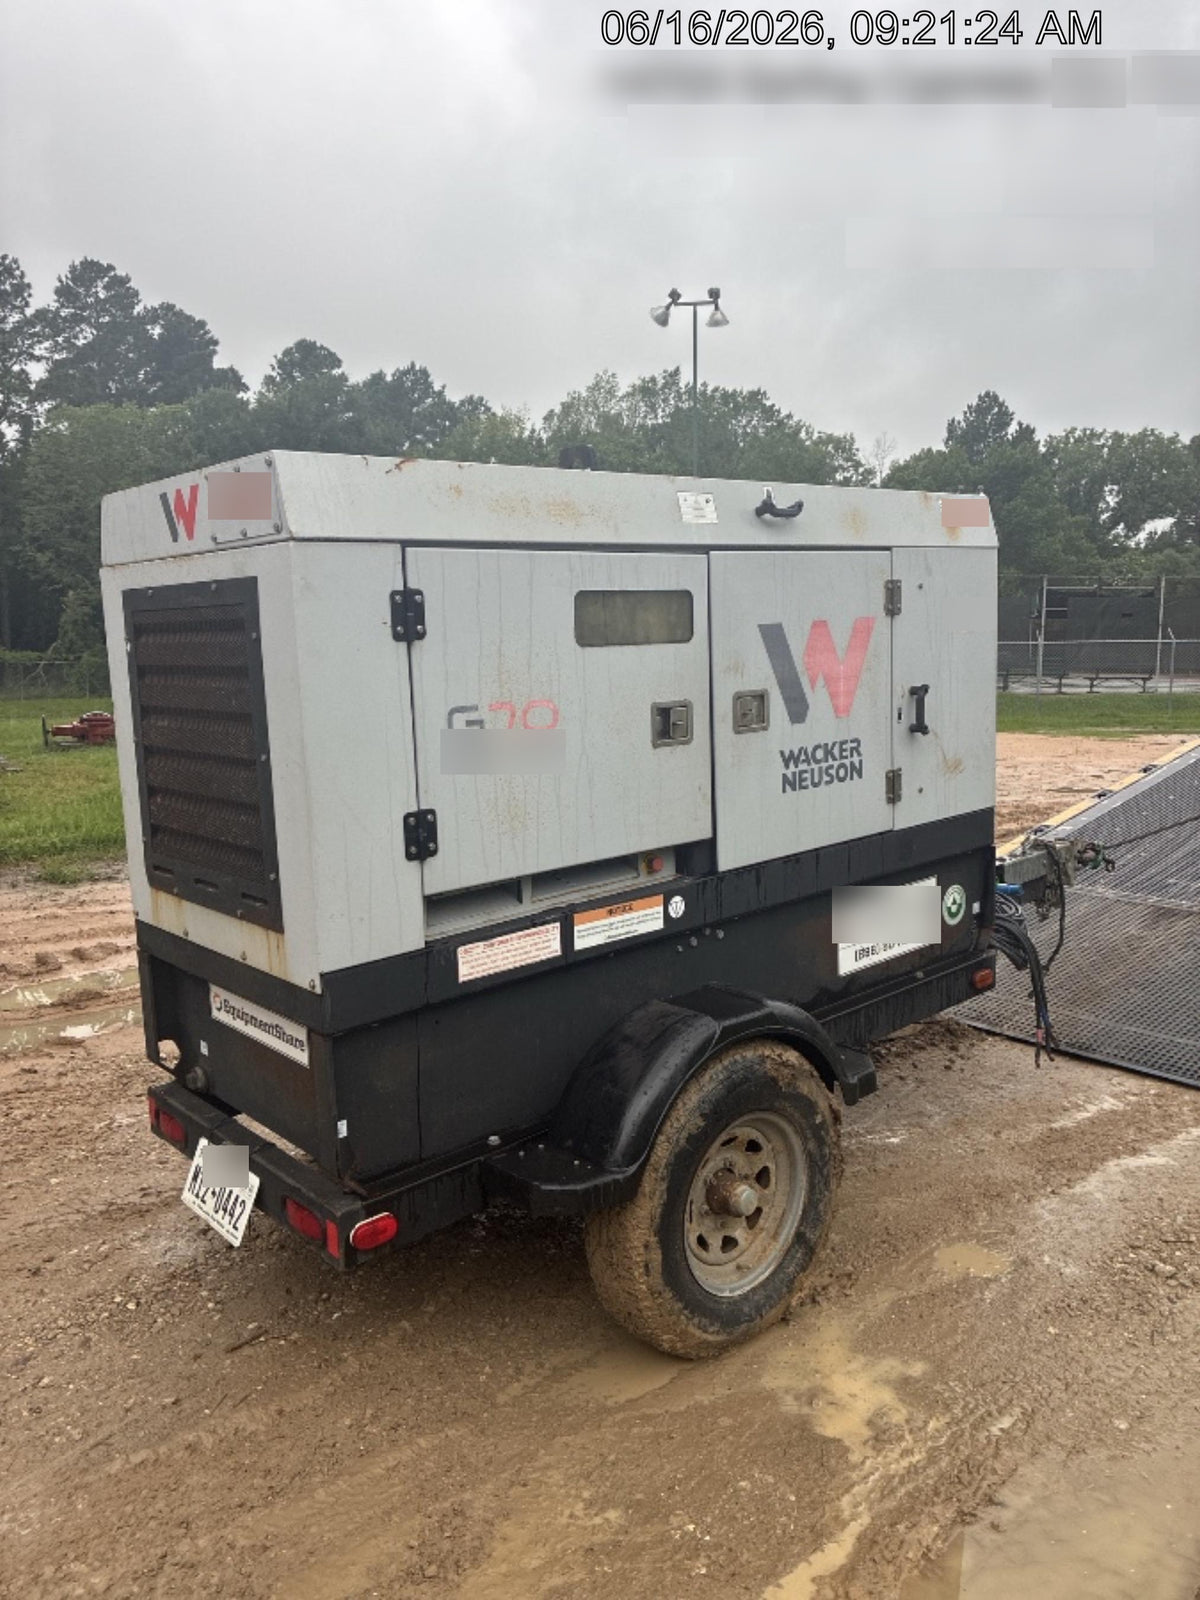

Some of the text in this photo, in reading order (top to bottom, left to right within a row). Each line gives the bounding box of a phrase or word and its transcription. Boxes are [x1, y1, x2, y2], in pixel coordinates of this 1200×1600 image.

[447, 699, 560, 730] G70
[779, 738, 861, 770] WACKER
[781, 760, 864, 793] NEUSON
[223, 998, 306, 1053] EquipmentShare
